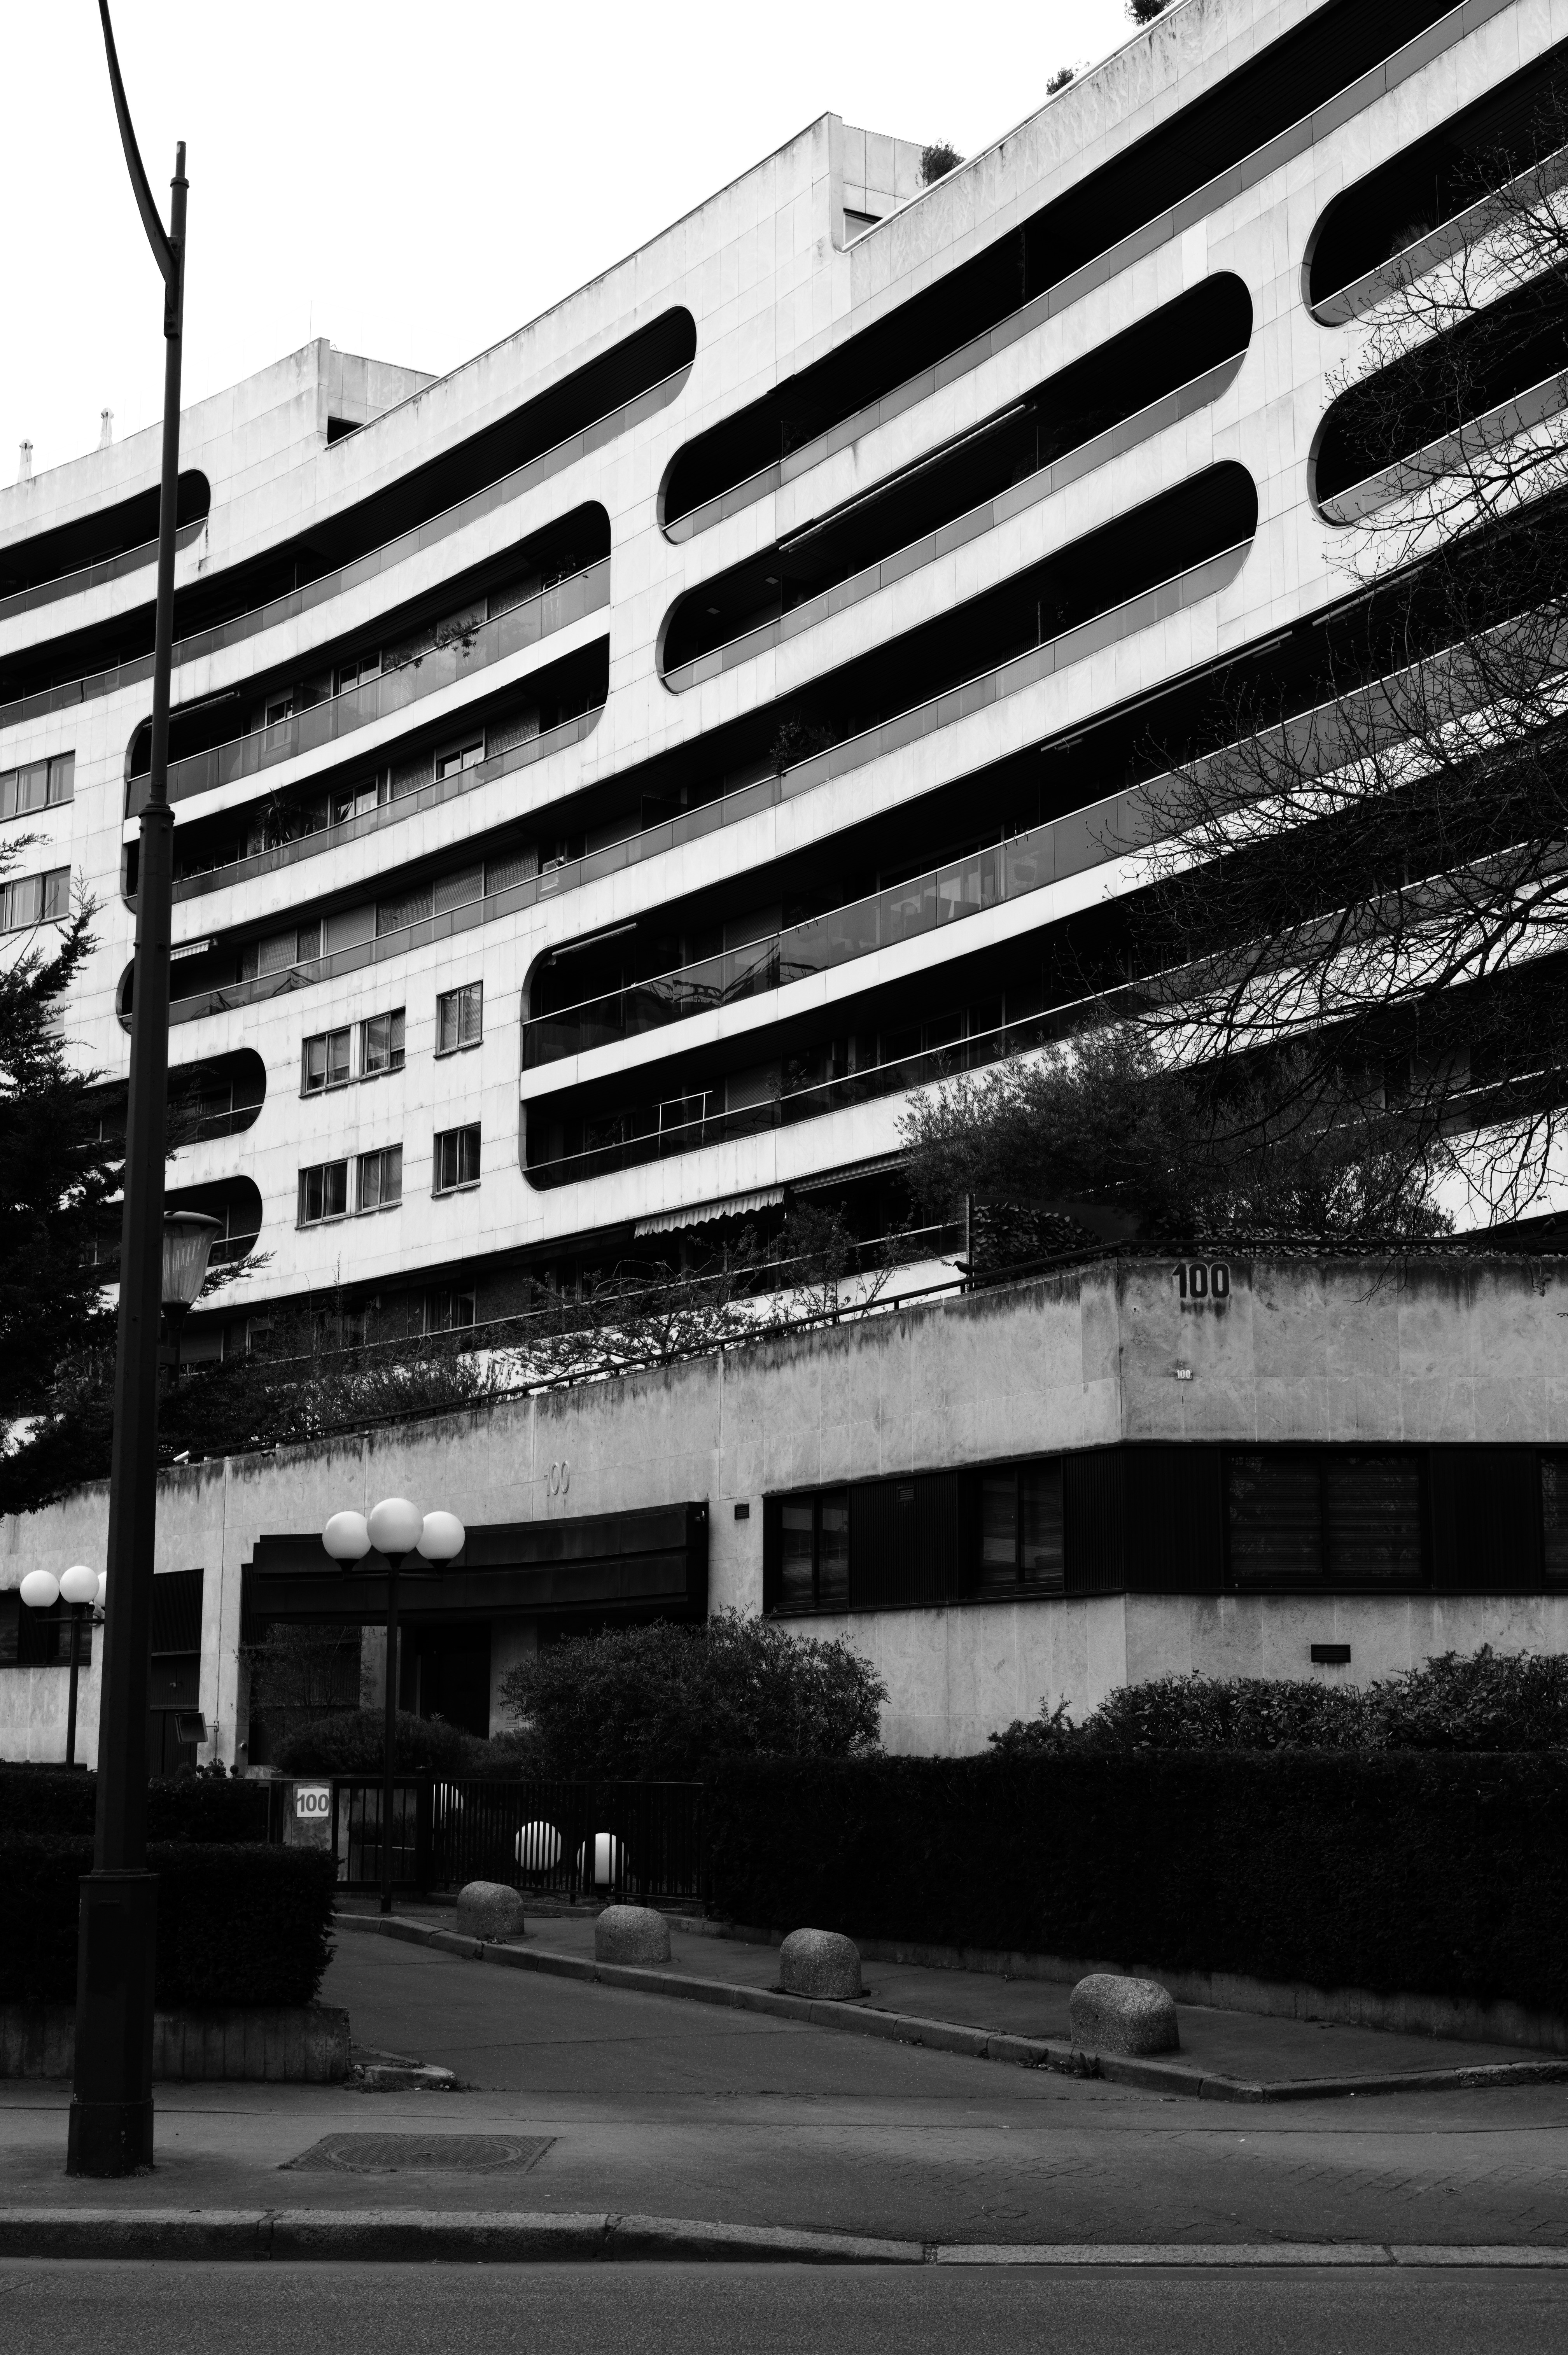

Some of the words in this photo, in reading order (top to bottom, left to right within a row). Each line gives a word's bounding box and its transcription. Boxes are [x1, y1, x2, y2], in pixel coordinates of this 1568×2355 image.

[1172, 1263, 1230, 1298] 100
[1176, 1370, 1191, 1378] 100
[544, 1461, 570, 1496] 100
[297, 1794, 329, 1812] 100
